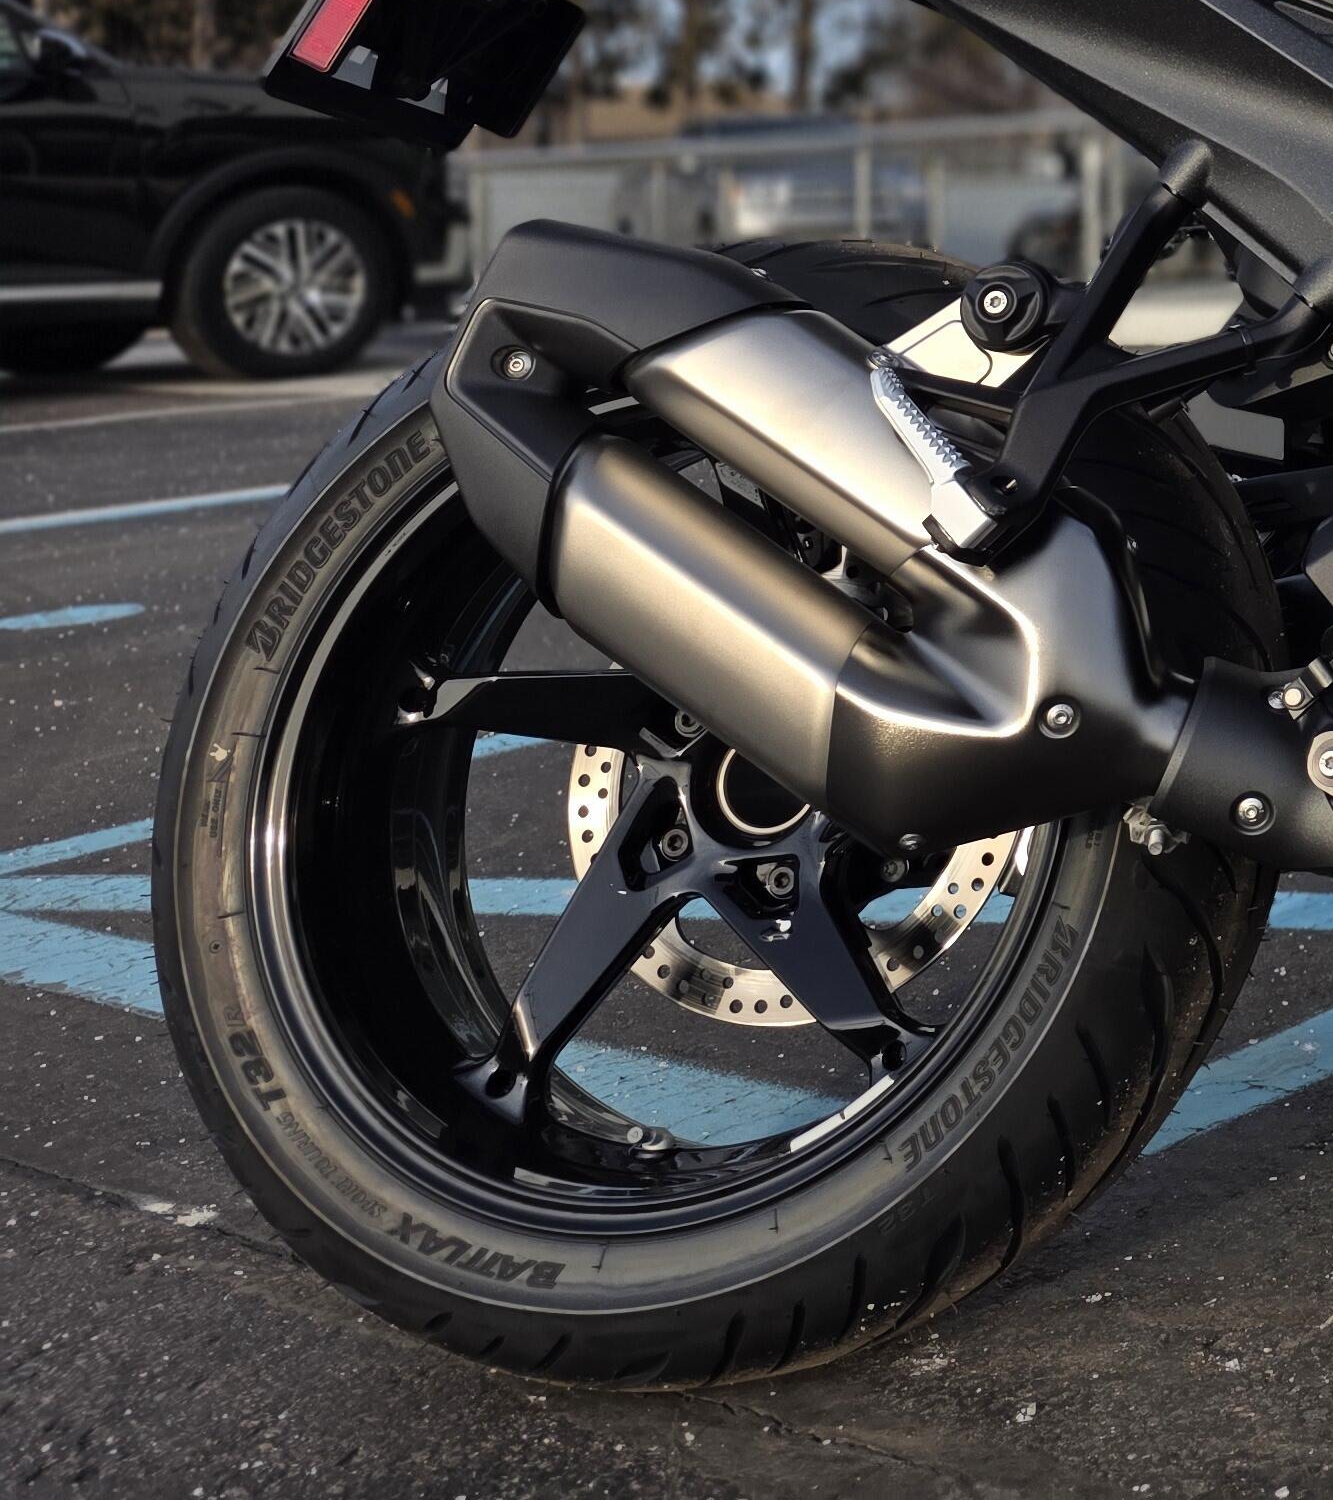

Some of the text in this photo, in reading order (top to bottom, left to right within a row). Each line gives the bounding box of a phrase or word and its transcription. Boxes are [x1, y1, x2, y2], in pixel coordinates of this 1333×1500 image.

[245, 428, 432, 662] BRIDGESTONE
[228, 1028, 287, 1111] T32
[897, 915, 1080, 1173] BRIDGESTONE
[276, 1111, 340, 1183] TOURING
[334, 1171, 388, 1219] SPORT
[384, 1211, 567, 1290] BATTLAX
